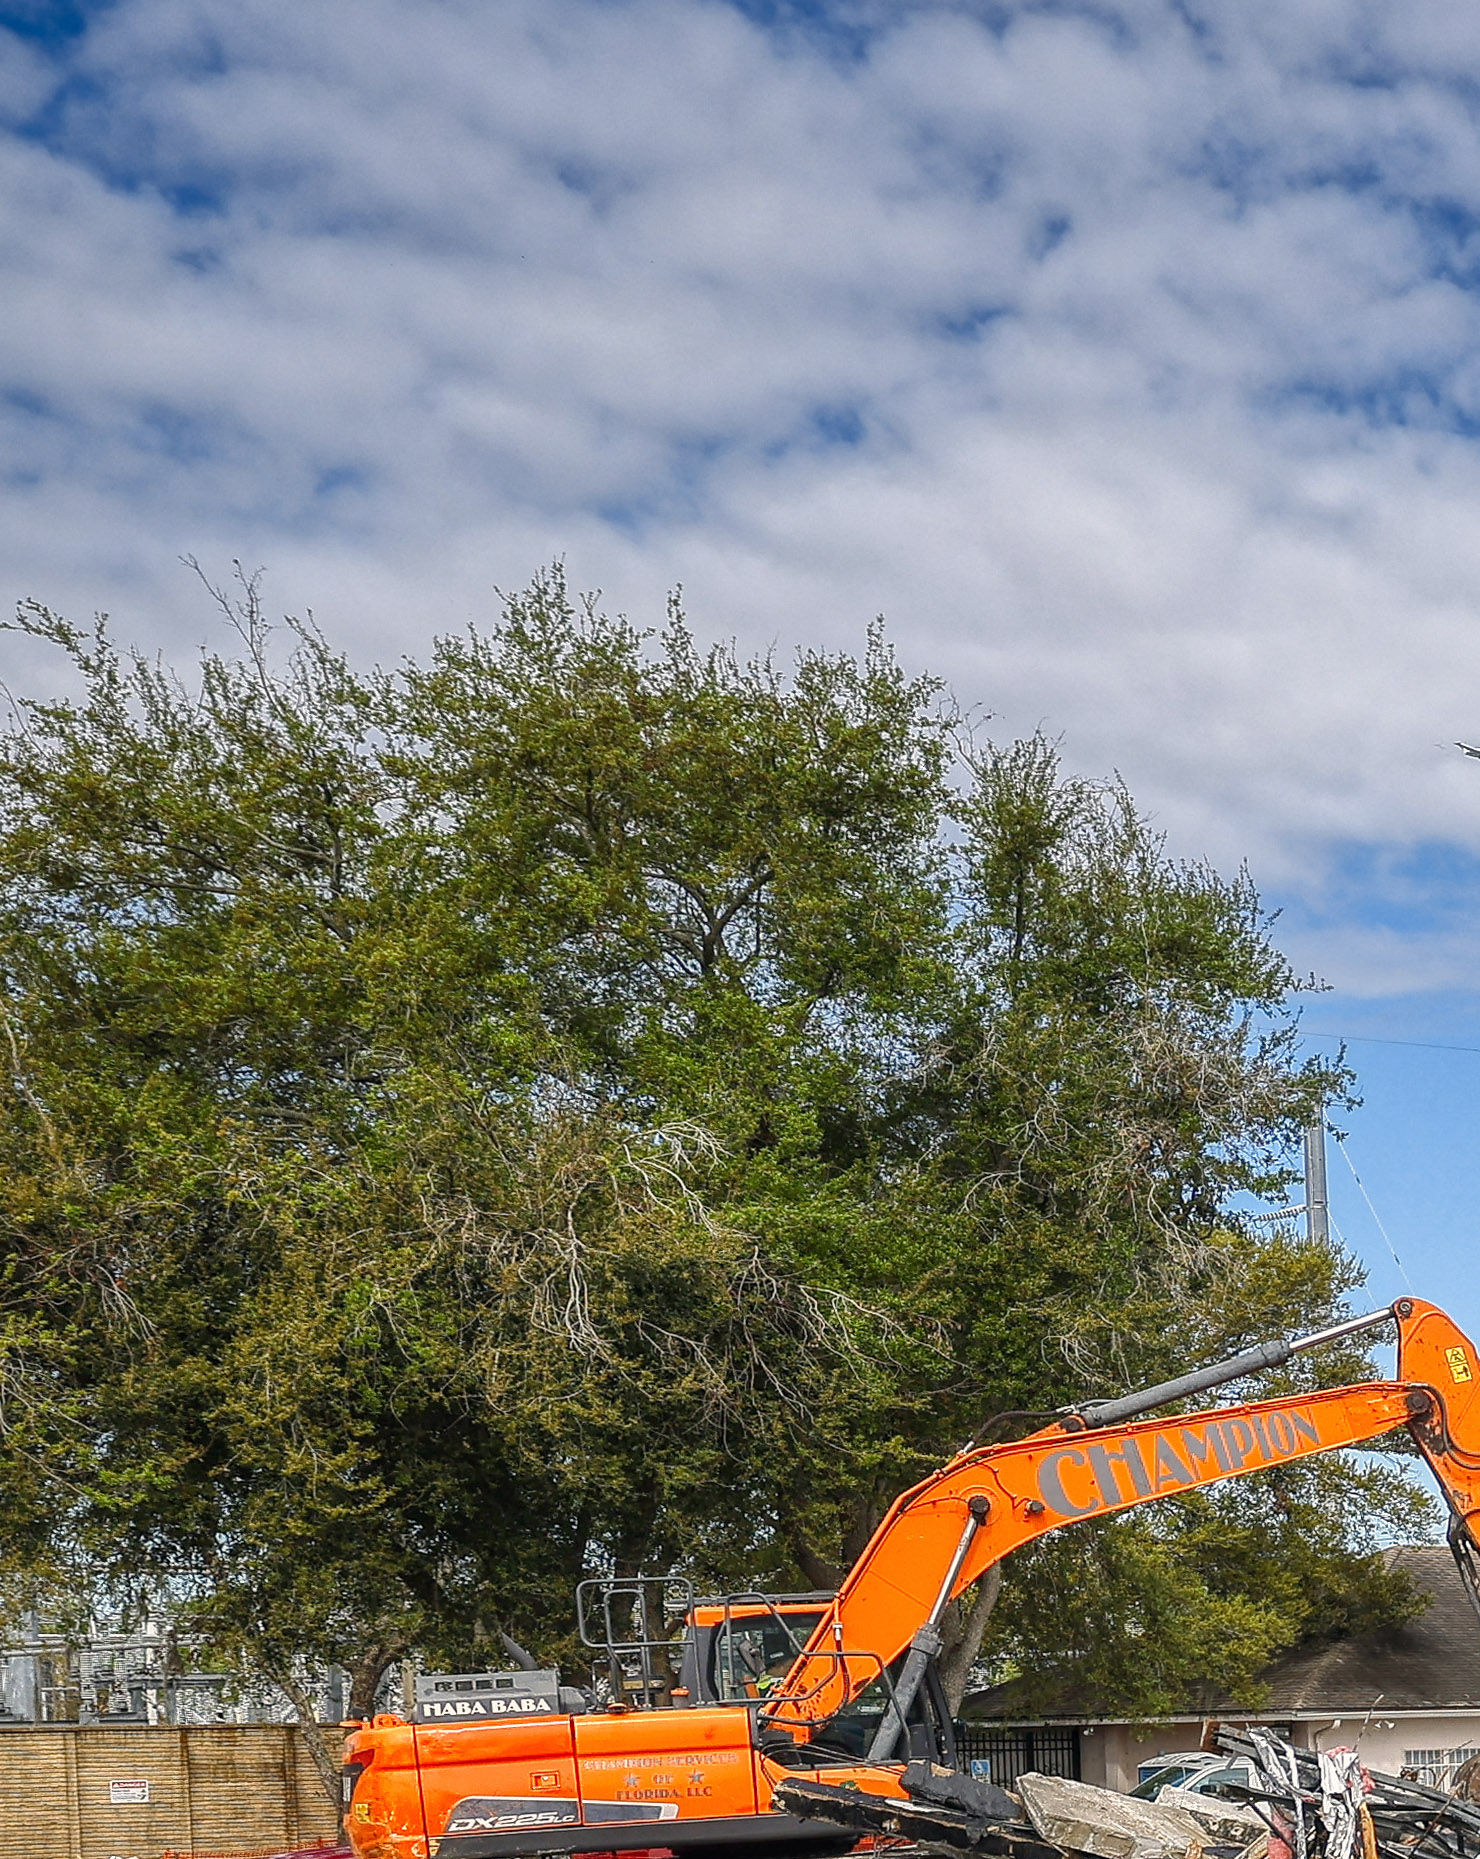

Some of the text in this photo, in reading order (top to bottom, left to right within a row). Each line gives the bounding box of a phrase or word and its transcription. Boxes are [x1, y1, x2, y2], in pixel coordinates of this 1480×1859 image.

[1037, 1407, 1320, 1516] CHAMPION
[423, 1698, 551, 1717] HABA BABA
[687, 1786, 713, 1797] LLC
